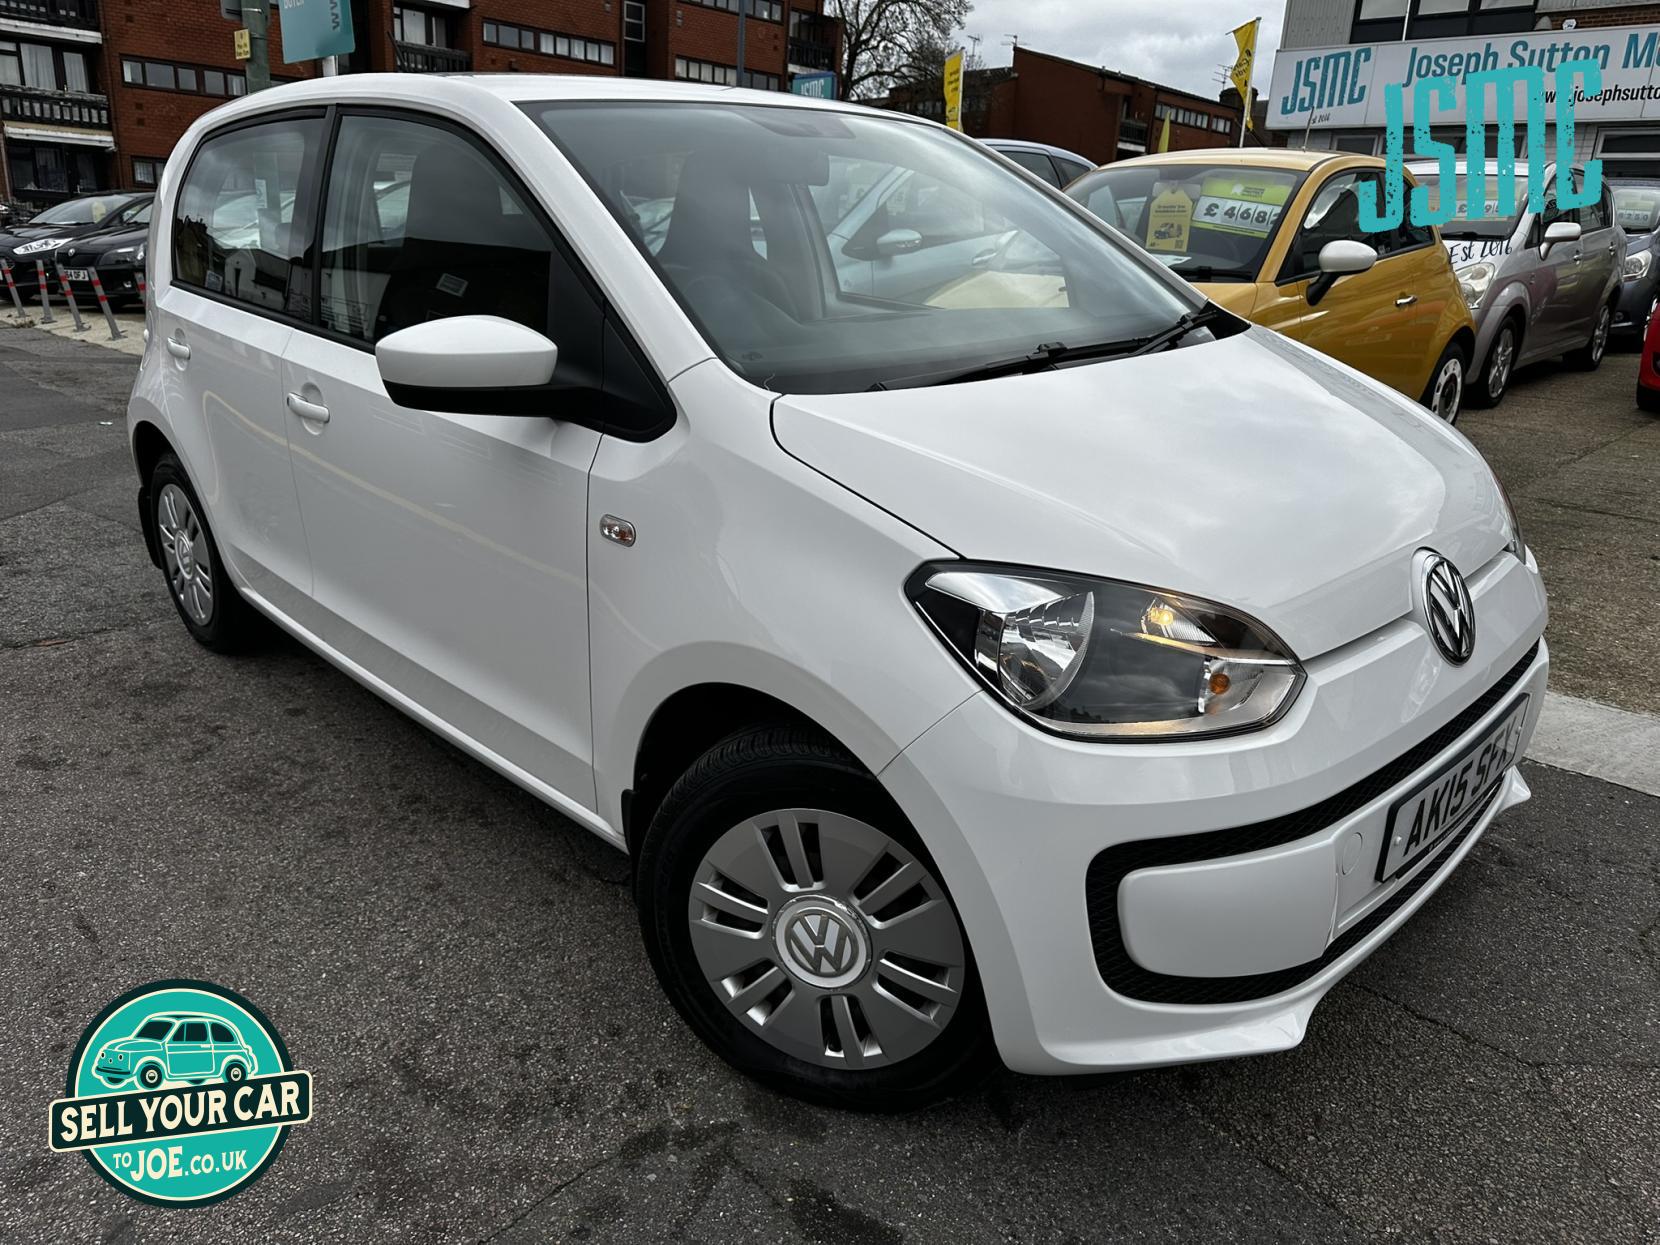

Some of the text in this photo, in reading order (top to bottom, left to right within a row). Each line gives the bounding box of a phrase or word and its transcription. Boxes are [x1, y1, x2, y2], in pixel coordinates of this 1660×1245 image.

[1281, 47, 1371, 115] JSMC
[1402, 42, 1499, 88] Joseph
[1507, 40, 1611, 73] Sutton
[1403, 759, 1474, 857] AK15
[1471, 716, 1517, 797] SFX
